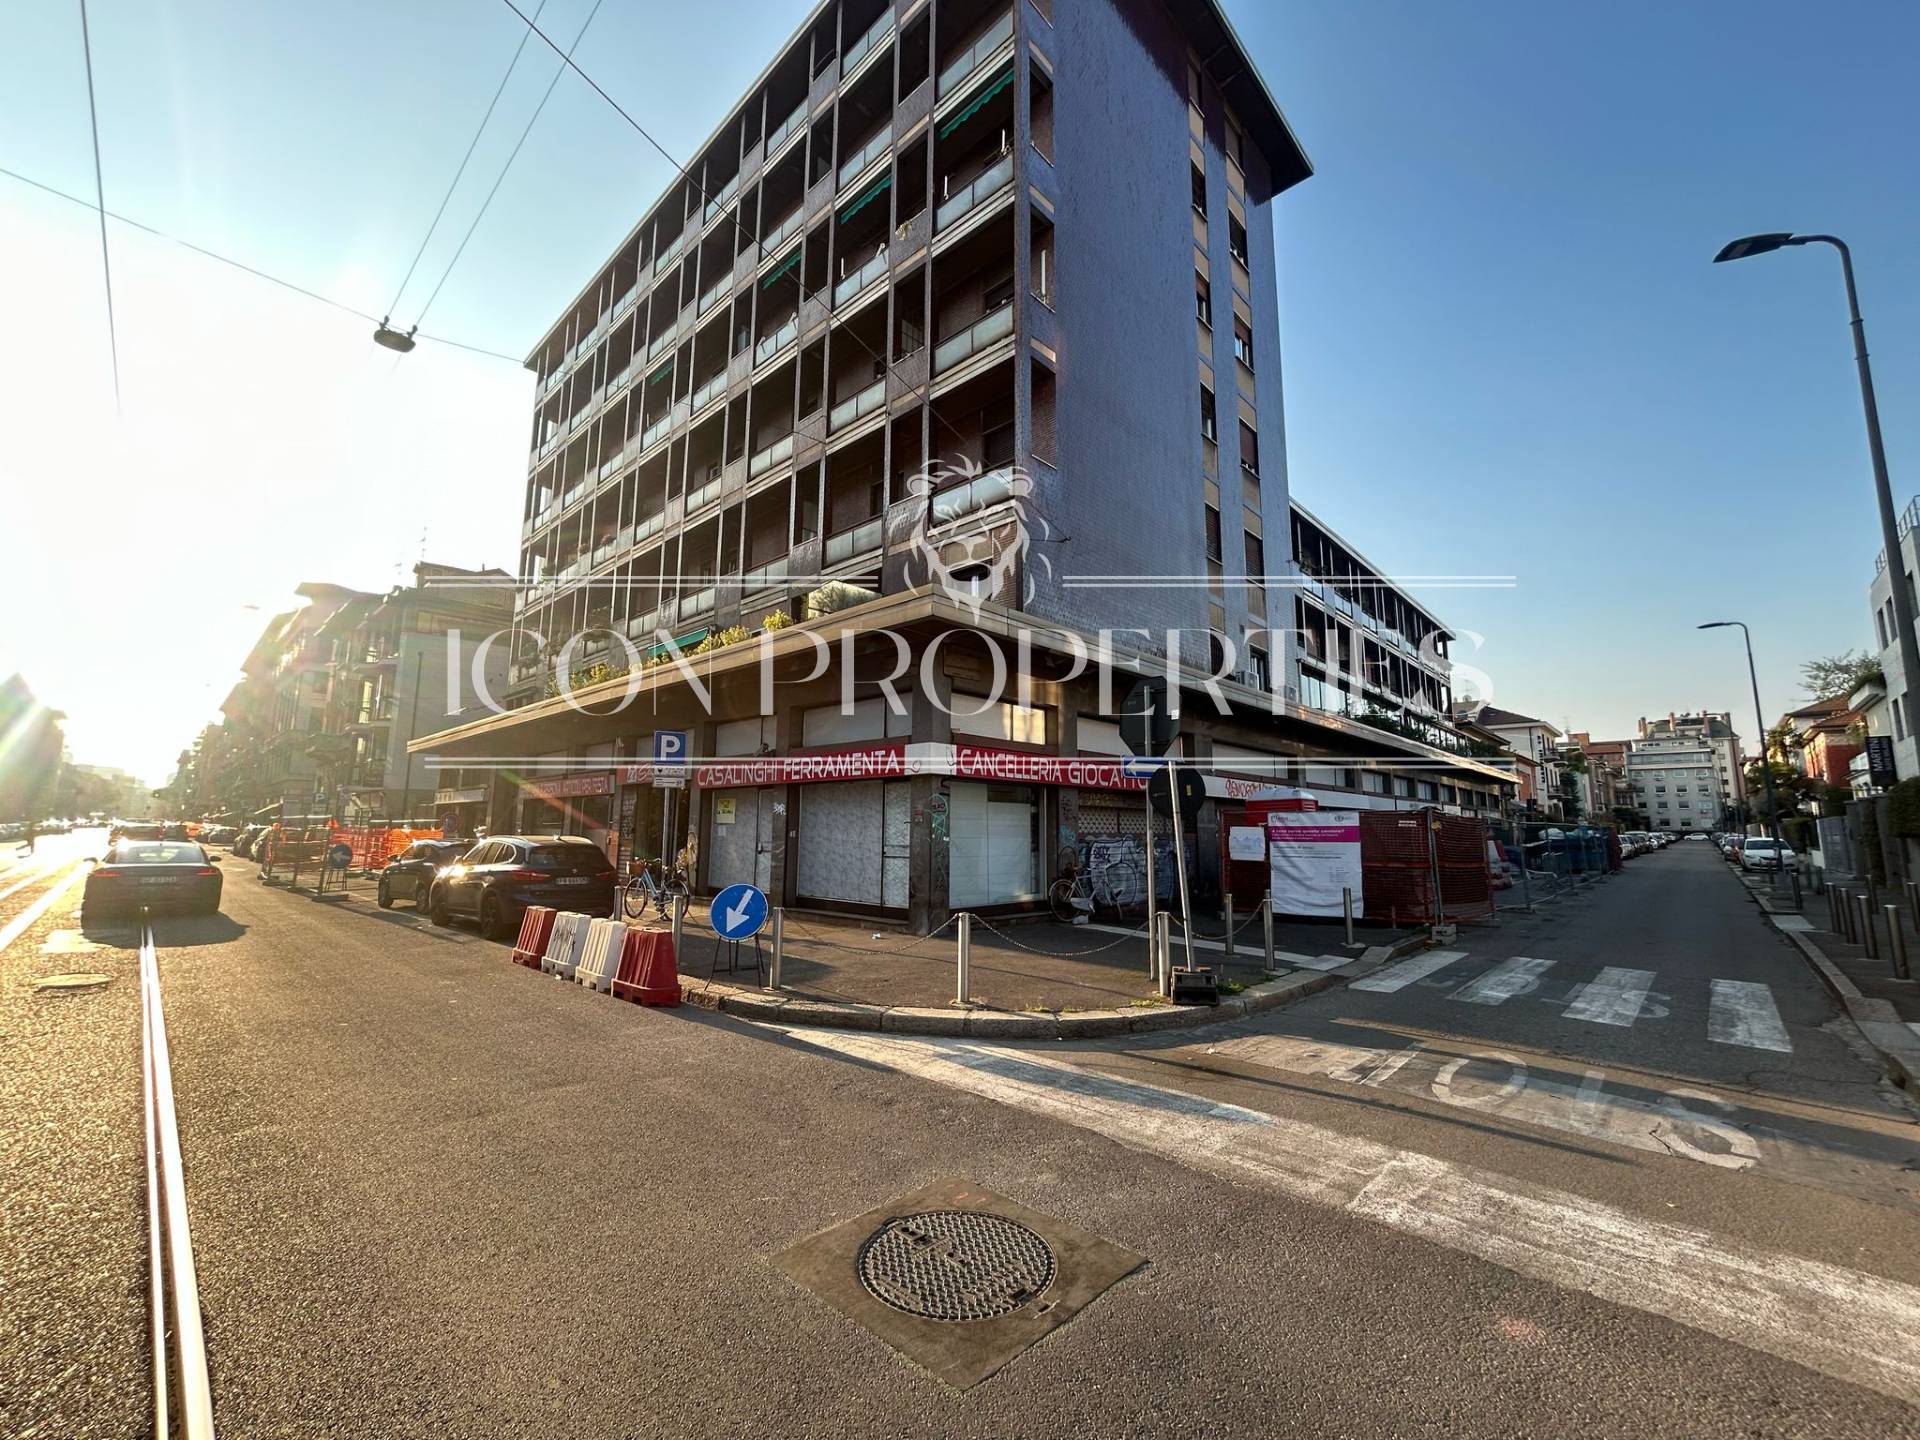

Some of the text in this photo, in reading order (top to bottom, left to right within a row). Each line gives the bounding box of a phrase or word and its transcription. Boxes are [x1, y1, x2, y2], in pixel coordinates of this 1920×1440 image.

[661, 735, 680, 760] P
[1868, 738, 1884, 772] MARTINI
[697, 749, 900, 786] CASALINGHI FERRAMENTA
[960, 748, 1062, 783] CANCELLERIA
